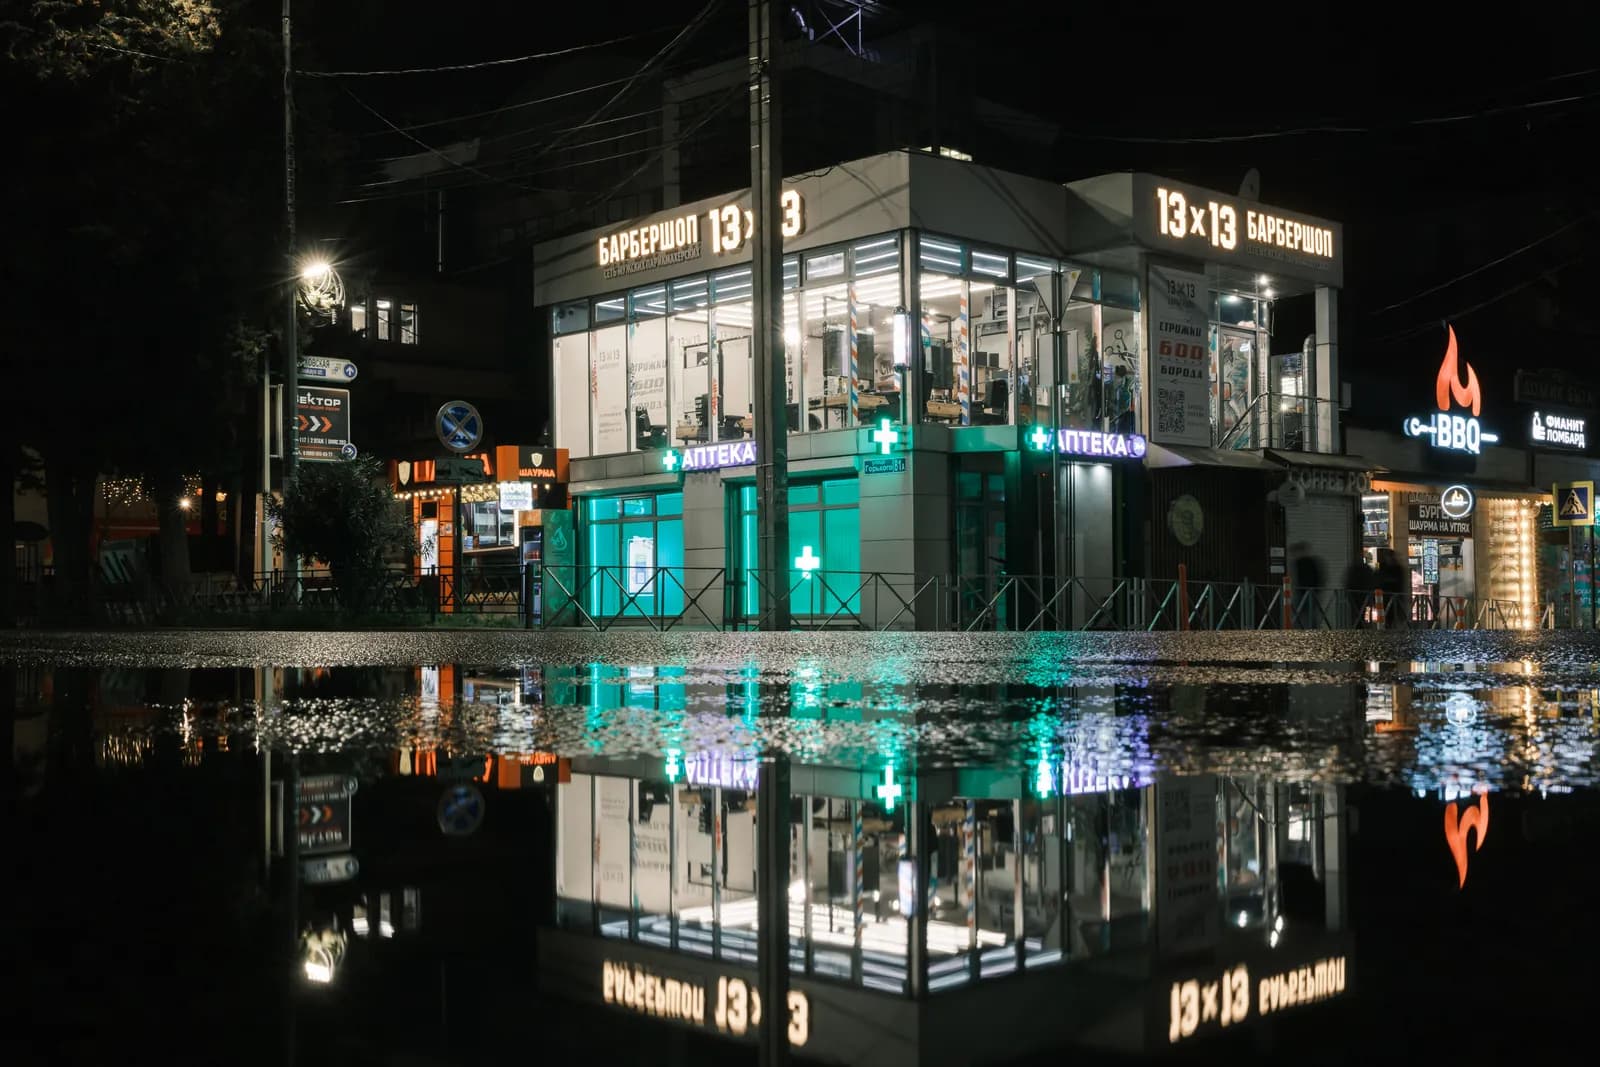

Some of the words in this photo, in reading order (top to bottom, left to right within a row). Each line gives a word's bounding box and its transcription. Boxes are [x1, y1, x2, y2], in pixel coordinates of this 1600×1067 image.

[598, 214, 698, 266] БАРБЕРШОП
[1247, 210, 1333, 258] БАРБЕРШОП
[1159, 321, 1202, 338] СТРИЖКИ
[1159, 339, 1204, 362] 600
[1160, 364, 1203, 380] БОРОДА
[297, 392, 341, 407] ЕКТОР
[1437, 413, 1480, 454] BBQ
[1545, 415, 1585, 433] ФИАНИТ
[1057, 429, 1128, 456] АПТЕКА
[1546, 428, 1586, 449] ЛОМБАРД
[682, 442, 756, 468] АПТЕКА
[1409, 519, 1438, 532] ШАУРМА
[1439, 521, 1449, 533] НА
[1449, 523, 1470, 533] УГЛЯХ
